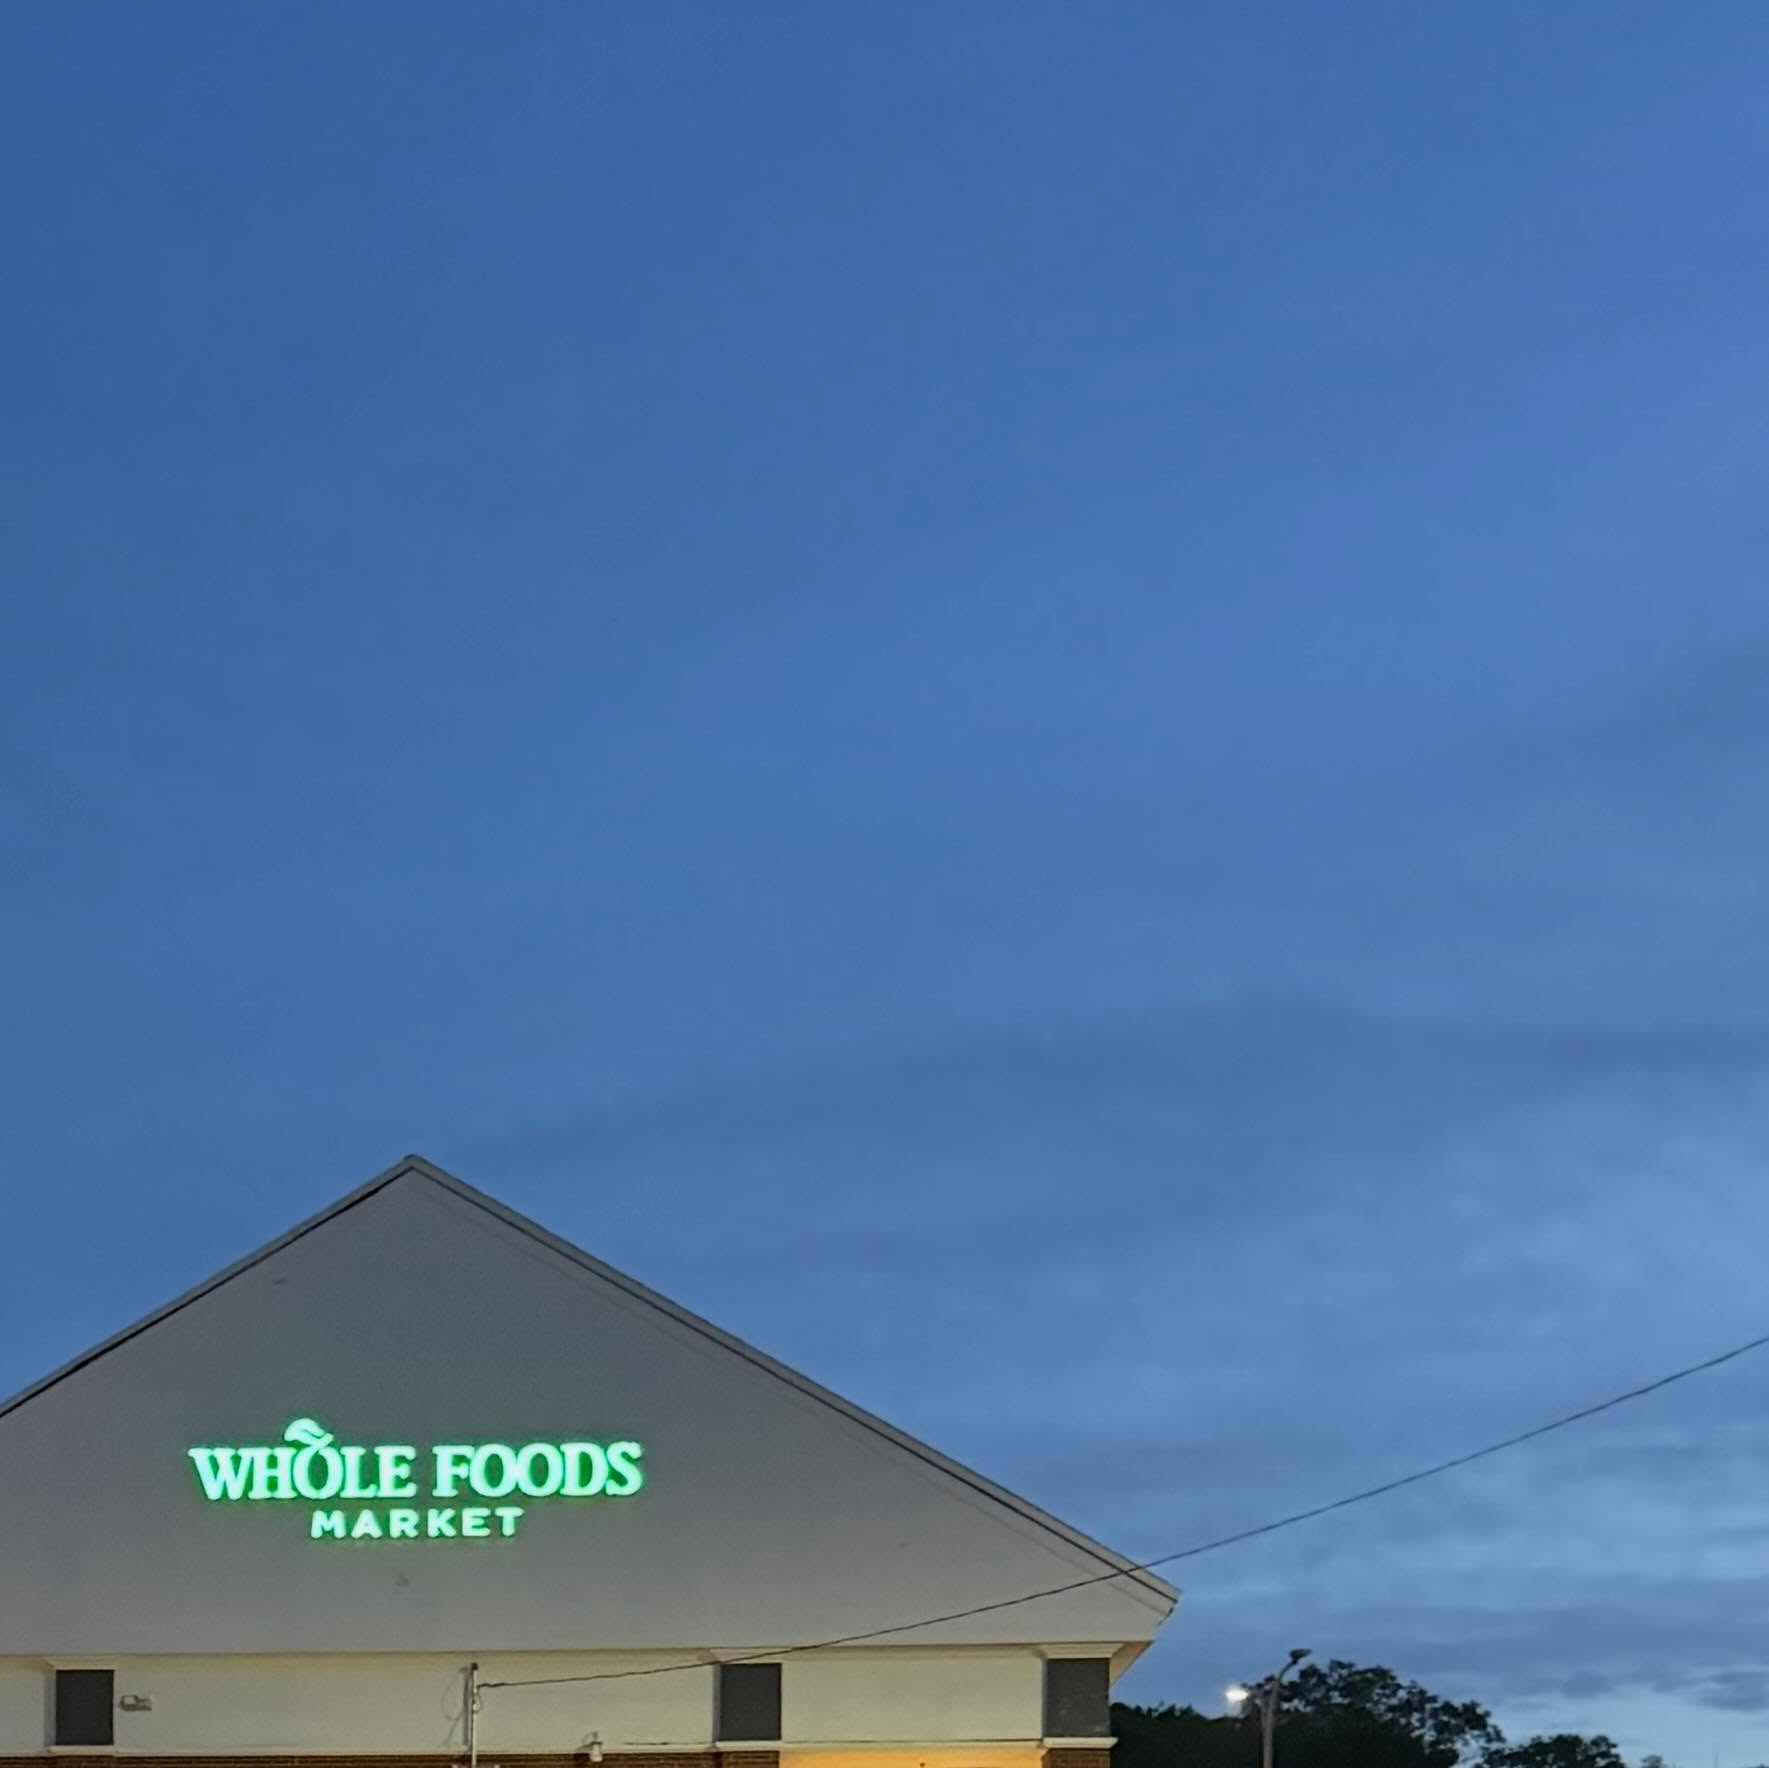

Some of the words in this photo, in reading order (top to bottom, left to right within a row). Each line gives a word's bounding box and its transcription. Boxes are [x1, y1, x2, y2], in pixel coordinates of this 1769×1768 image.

[187, 1440, 418, 1500] WHOLE
[431, 1440, 644, 1498] FOODS
[310, 1506, 525, 1539] MARKET
